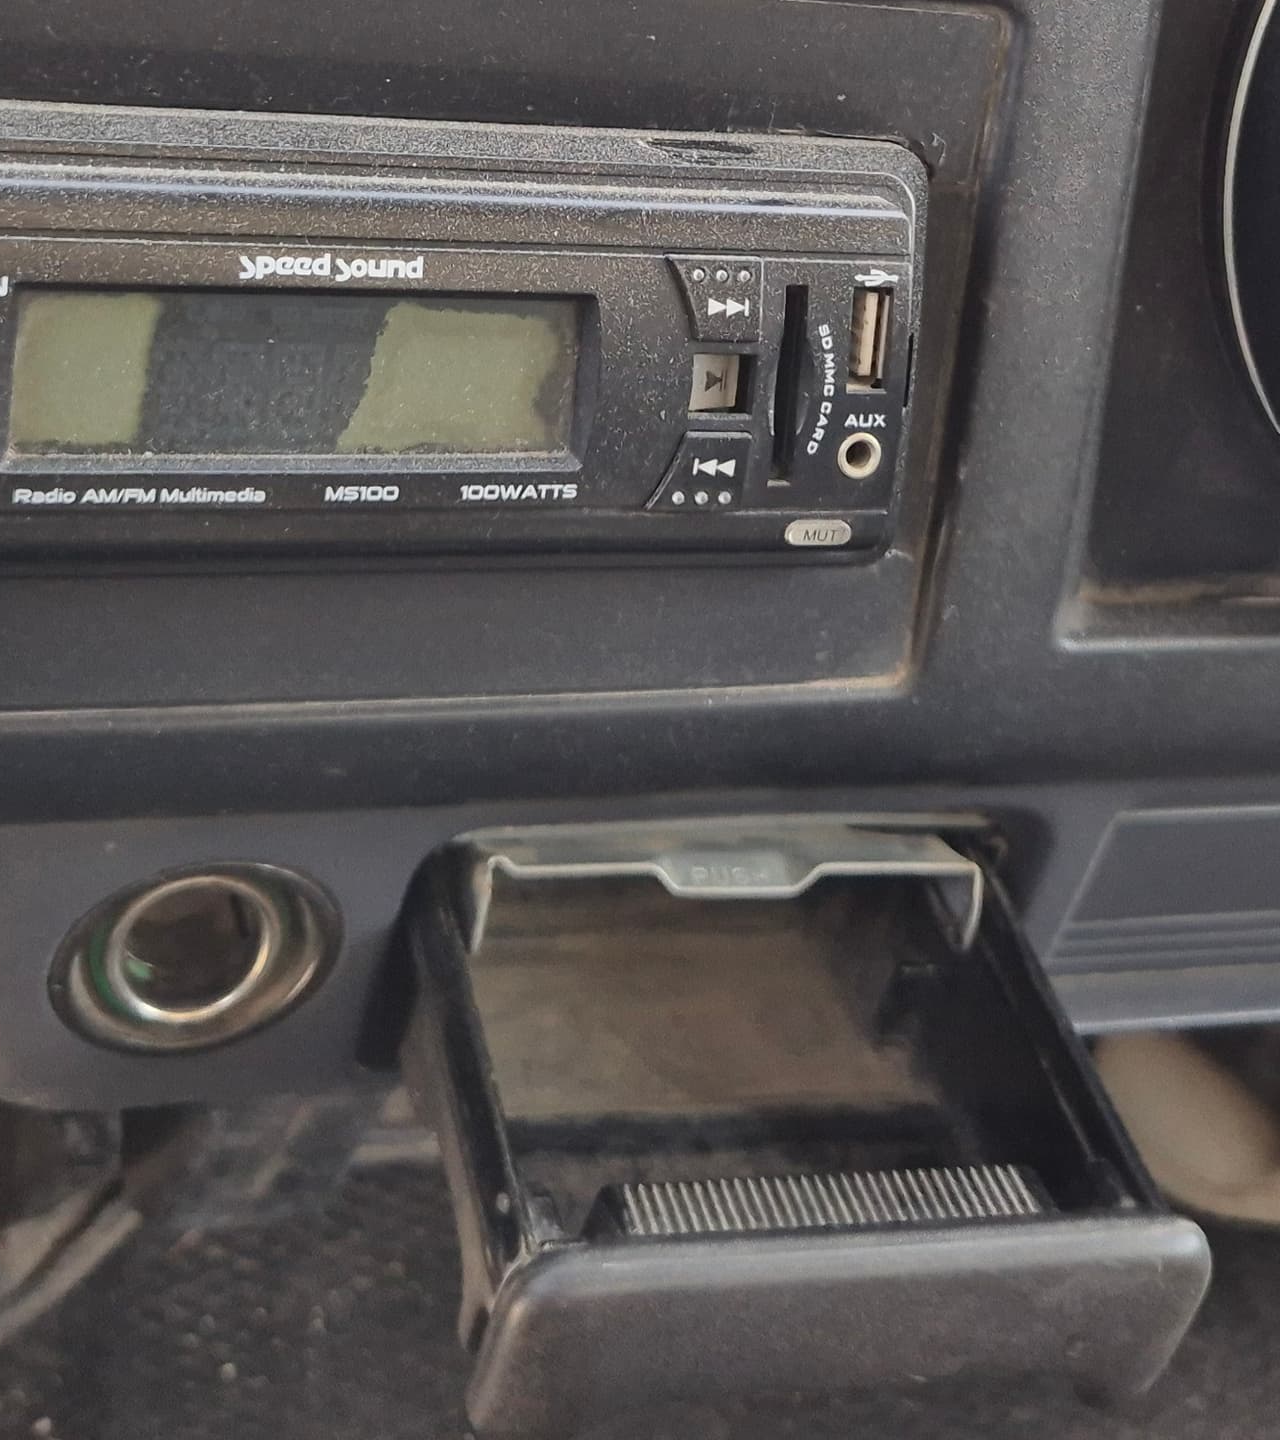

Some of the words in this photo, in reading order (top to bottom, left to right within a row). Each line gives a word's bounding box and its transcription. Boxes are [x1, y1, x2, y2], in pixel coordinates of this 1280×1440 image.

[818, 324, 834, 350] SD
[823, 353, 835, 397] MMC
[806, 401, 832, 455] CARD
[844, 413, 887, 428] AUX
[12, 488, 77, 504] Radio
[80, 488, 156, 504] AM/FM
[159, 487, 267, 504] Multimedia
[324, 485, 400, 502] MS100
[459, 483, 579, 501] 100WATTS
[802, 528, 839, 543] MUT
